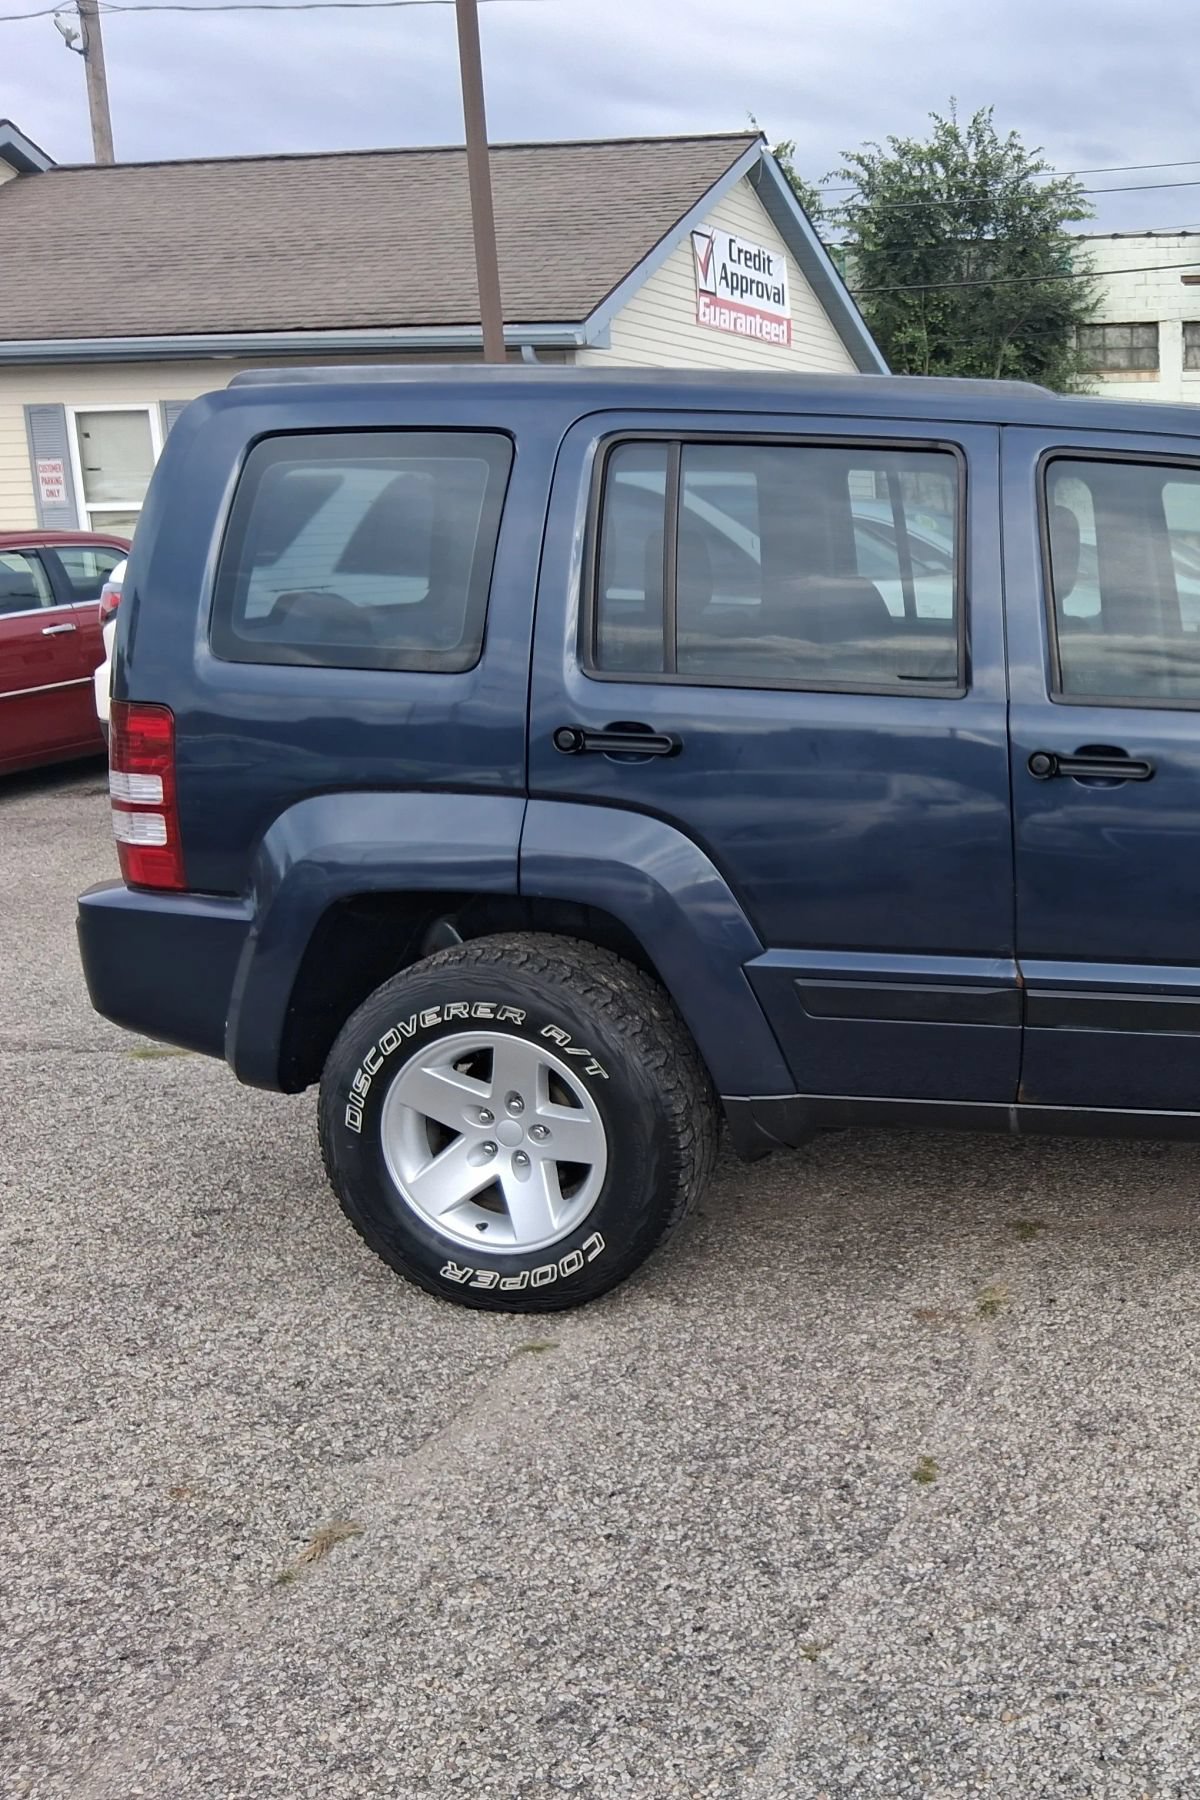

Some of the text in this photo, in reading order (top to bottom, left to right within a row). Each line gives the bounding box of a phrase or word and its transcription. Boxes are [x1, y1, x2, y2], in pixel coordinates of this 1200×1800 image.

[728, 238, 773, 277] Credit
[719, 262, 785, 306] Approval
[700, 296, 788, 344] Guaranteed
[39, 464, 62, 473] CUSTOMER
[41, 476, 62, 485] PARKING
[46, 488, 60, 498] ONLY
[345, 1002, 610, 1134] DISCOVERER A/T
[440, 1231, 606, 1291] COOPER
